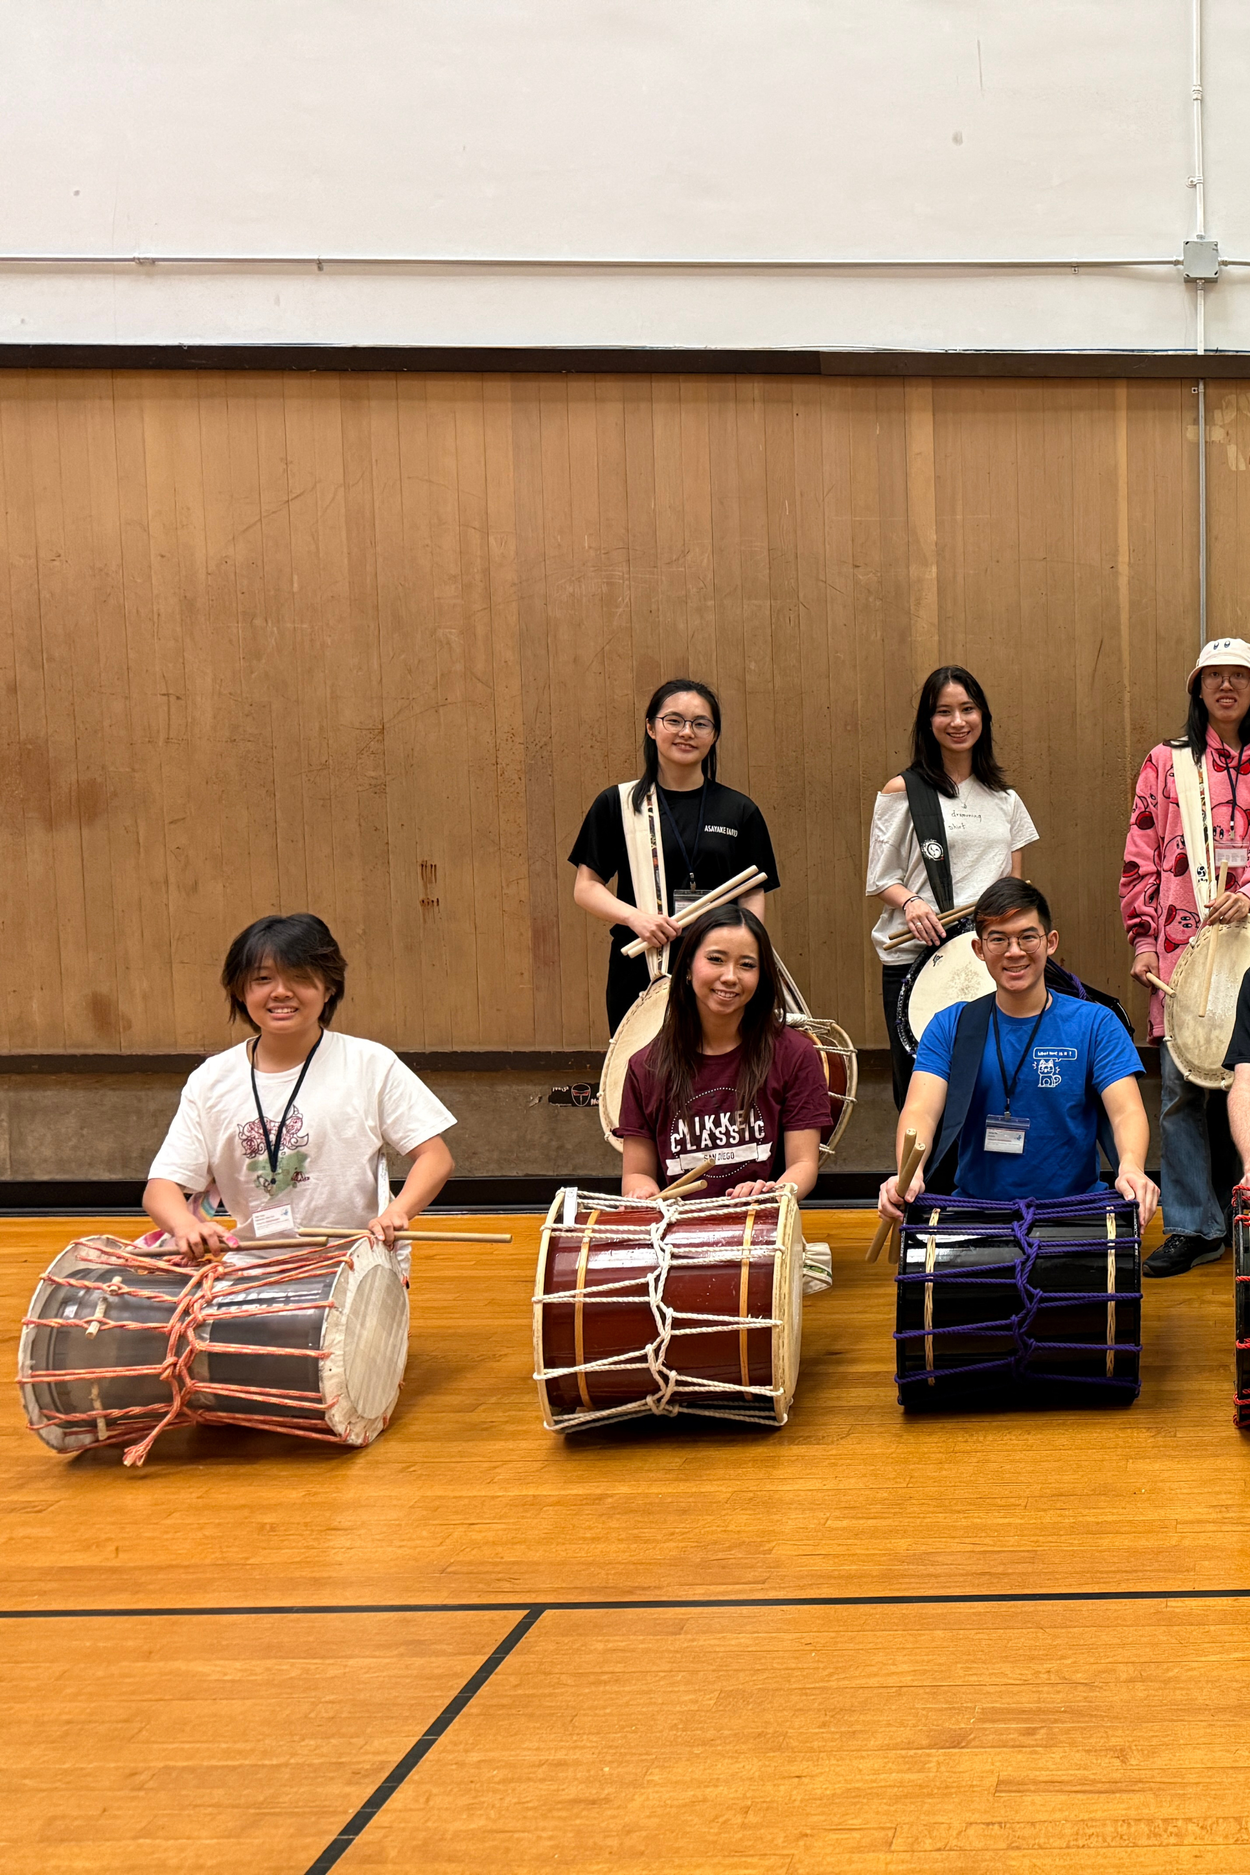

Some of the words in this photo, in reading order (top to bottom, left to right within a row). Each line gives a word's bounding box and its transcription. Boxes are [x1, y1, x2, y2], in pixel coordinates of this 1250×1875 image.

[670, 1120, 765, 1153] CLASSIC
[678, 1108, 755, 1138] NIKKEI
[717, 1151, 735, 1160] DIEGO
